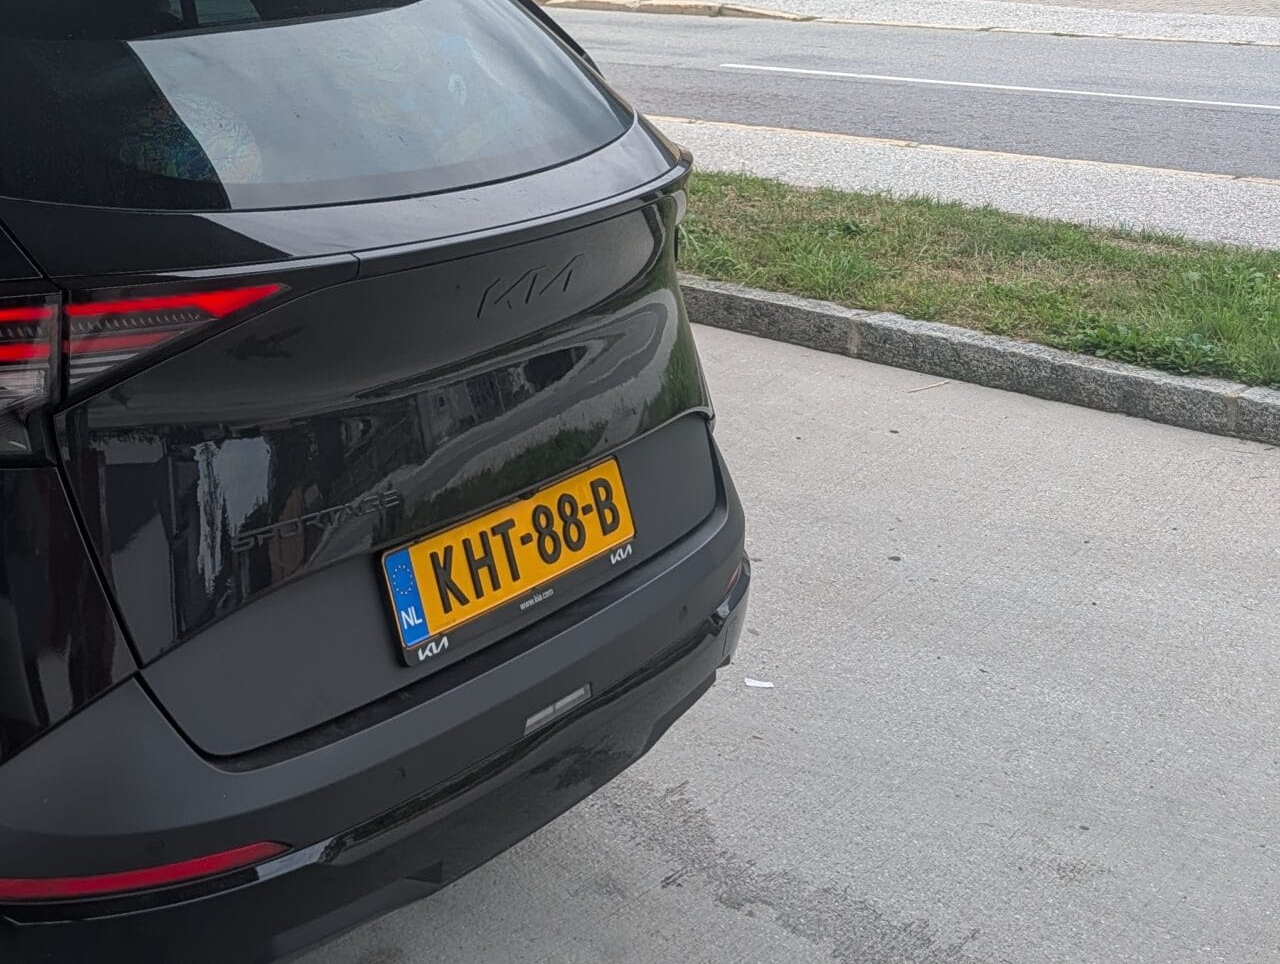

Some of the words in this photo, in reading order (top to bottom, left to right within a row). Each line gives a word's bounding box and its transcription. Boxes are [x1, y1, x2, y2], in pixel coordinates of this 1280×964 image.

[477, 253, 584, 318] KIA
[231, 489, 401, 553] SPORTAGE
[429, 477, 621, 615] KHT-88-B
[610, 543, 633, 565] KIA
[520, 588, 555, 611] www.kia.com
[400, 605, 423, 630] NL
[417, 636, 449, 661] KIA
